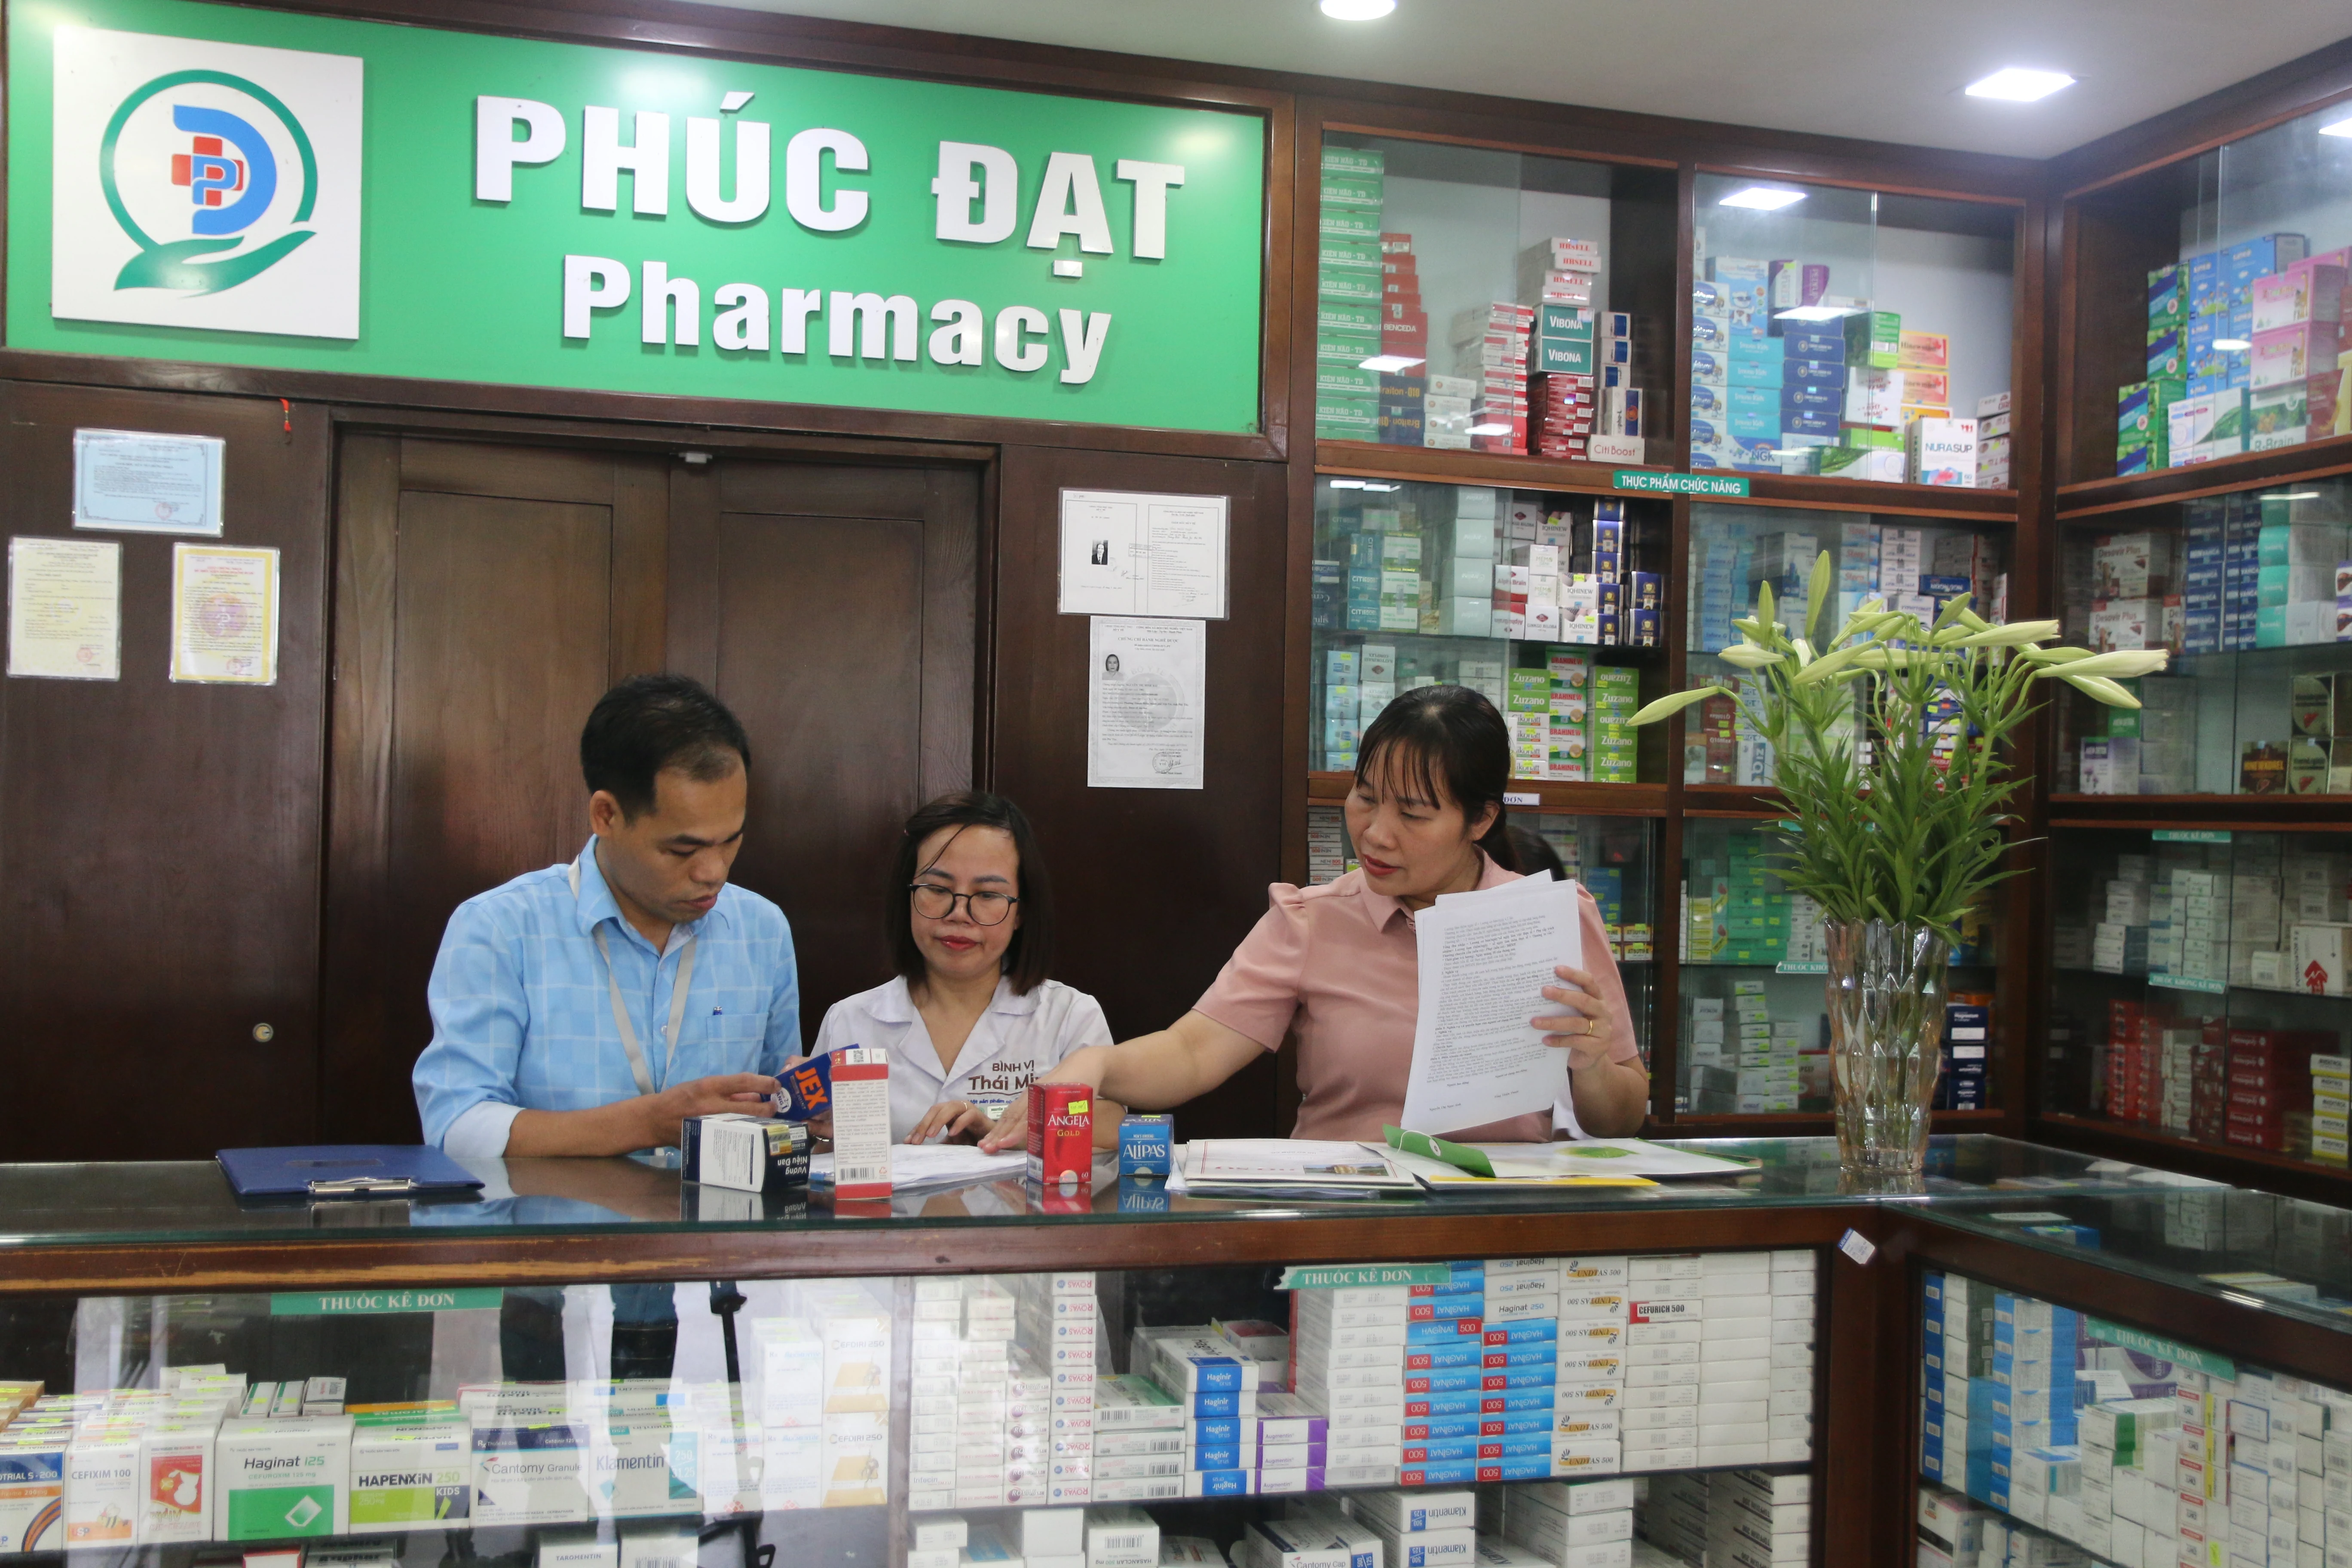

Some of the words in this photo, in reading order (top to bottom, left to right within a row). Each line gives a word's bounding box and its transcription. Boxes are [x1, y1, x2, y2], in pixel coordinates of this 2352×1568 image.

[476, 92, 868, 232] PHÚC
[931, 141, 1185, 277] ĐẠT
[564, 254, 1112, 384] Pharmacy
[1549, 315, 1583, 330] VIBONA
[1548, 349, 1581, 363] VIBONA
[1594, 444, 1609, 454] Citi
[1611, 445, 1635, 457] Boost
[1925, 443, 1973, 453] NURASUP
[1622, 475, 1647, 490] THỰC
[1650, 473, 1678, 490] PHẨM
[1680, 478, 1709, 492] CHỨC
[1711, 480, 1741, 494] NĂNG
[1513, 673, 1545, 683] Zuzano
[1600, 674, 1632, 684] Zuzano
[1513, 695, 1545, 705] Zuzano
[1602, 693, 1633, 703] Zuzano
[1602, 736, 1632, 745] Zuzano
[1601, 757, 1632, 766] Zuzano
[1783, 962, 1808, 971] THUỐC
[1810, 963, 1828, 971] KHÔ
[992, 1061, 1021, 1072] BÌNH
[1023, 1060, 1034, 1071] VỊ
[968, 1074, 1009, 1090] Thái
[795, 1067, 828, 1111] JEX
[1047, 1114, 1089, 1127] ANGELA
[793, 1155, 807, 1165] Niệu
[785, 1167, 806, 1175] Vương
[1303, 1270, 1354, 1285] THUỐC
[1358, 1267, 1378, 1283] KÊ
[1382, 1270, 1412, 1282] ĐƠN
[1067, 1280, 1092, 1288] ROVAS
[319, 1295, 383, 1310] THUỐC
[387, 1289, 412, 1309] KÊ
[416, 1292, 455, 1307] ĐƠN
[1069, 1303, 1093, 1311] ROVAS
[1415, 1307, 1431, 1316] 500
[1499, 1305, 1528, 1314] Haginat
[1638, 1305, 1671, 1315] CEFURICH
[1671, 1304, 1685, 1313] 500
[1069, 1326, 1093, 1335] ROVAS
[1421, 1325, 1455, 1336] HAGINAT
[1460, 1323, 1476, 1332] 500
[1489, 1333, 1505, 1341] 500
[831, 1339, 867, 1350] CEFDIRI
[868, 1339, 885, 1348] 250
[2116, 1329, 2155, 1350] THUỐC
[2157, 1341, 2174, 1356] KÊ
[2177, 1348, 2202, 1366] ĐƠN
[1067, 1350, 1092, 1358] ROVAS
[1412, 1356, 1429, 1365] 500
[1207, 1372, 1232, 1383] Haginir
[1204, 1397, 1229, 1407] Haginir
[1206, 1424, 1231, 1434] Haginir
[829, 1433, 864, 1444] CEFDIRI
[675, 1450, 692, 1461] 250
[1204, 1451, 1230, 1461] Haginir
[244, 1455, 300, 1470] Haginat
[304, 1456, 325, 1466] 125
[596, 1454, 665, 1471] Klamentin
[71, 1470, 111, 1479] CEFIXIM
[113, 1469, 131, 1477] 100
[492, 1463, 544, 1475] Cantomy
[548, 1464, 582, 1472] Granule
[672, 1467, 695, 1478] 31.25
[436, 1472, 460, 1483] 250
[913, 1476, 938, 1484] Infecin
[1212, 1479, 1237, 1490] Haginir
[436, 1487, 460, 1496] KIDS
[1428, 1507, 1466, 1518] Klamentin
[1427, 1544, 1466, 1554] Klamentin
[556, 1553, 602, 1561] TAROMENTIN
